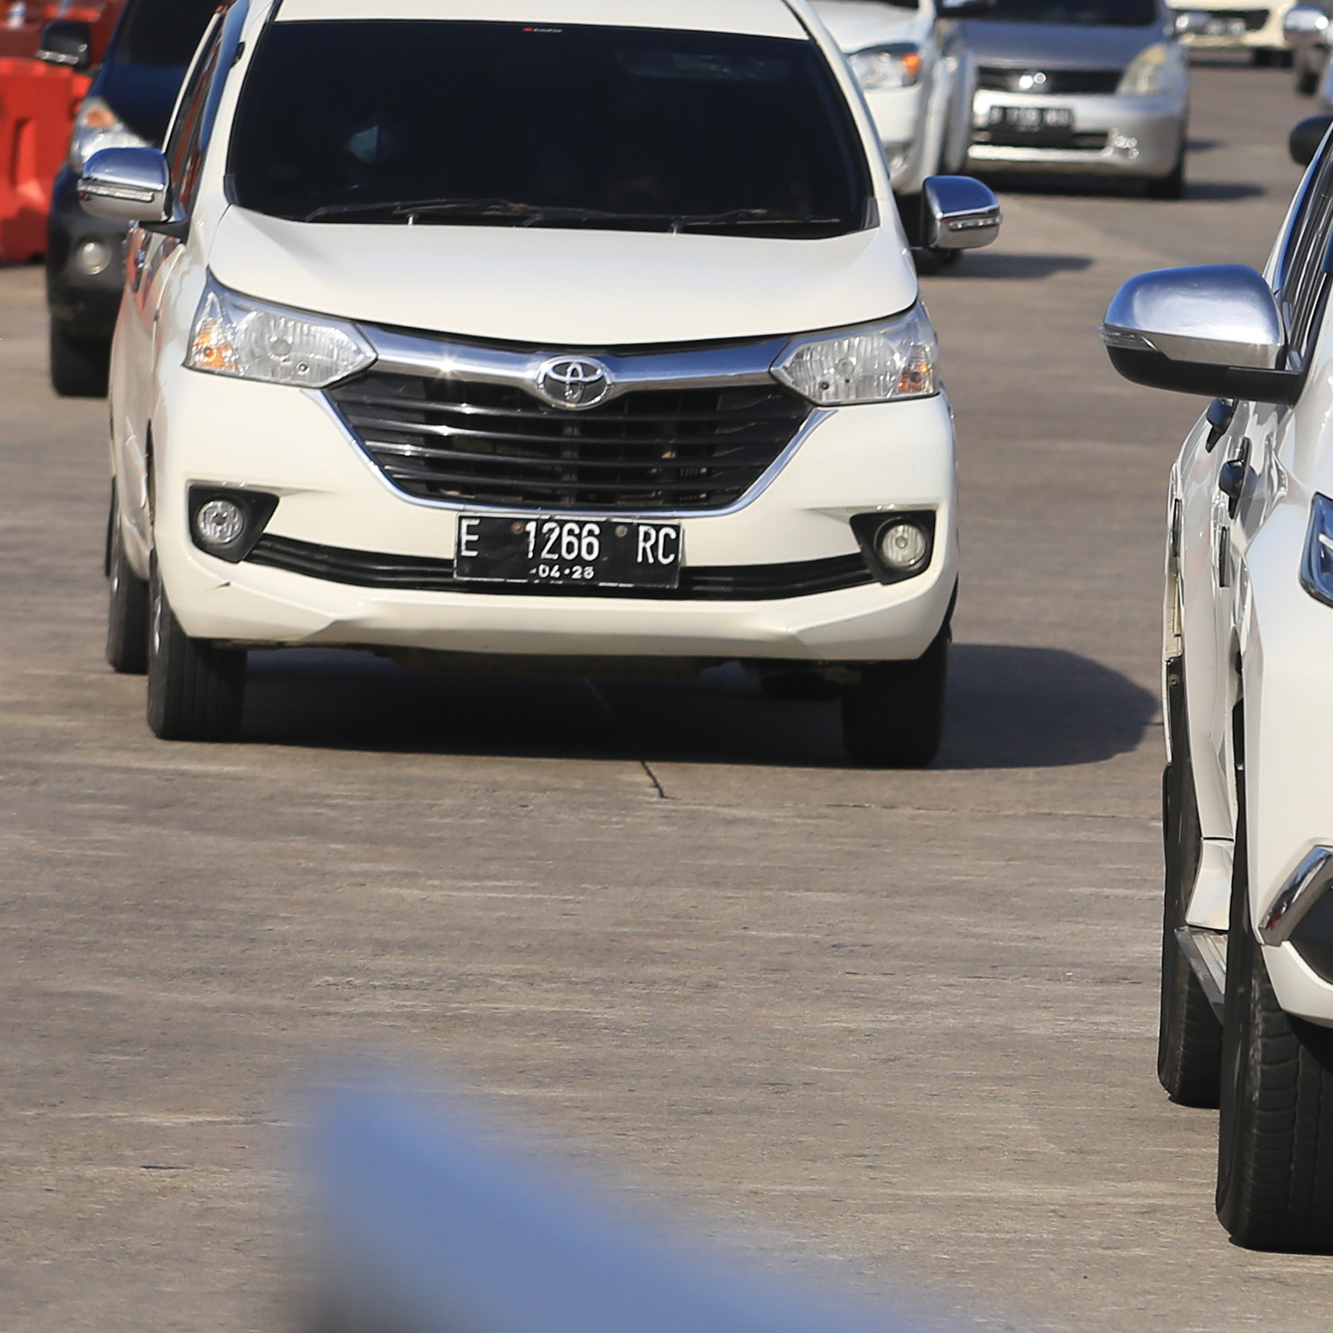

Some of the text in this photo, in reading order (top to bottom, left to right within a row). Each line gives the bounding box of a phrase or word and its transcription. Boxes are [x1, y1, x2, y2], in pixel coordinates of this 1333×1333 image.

[460, 518, 677, 565] E 1266 RC
